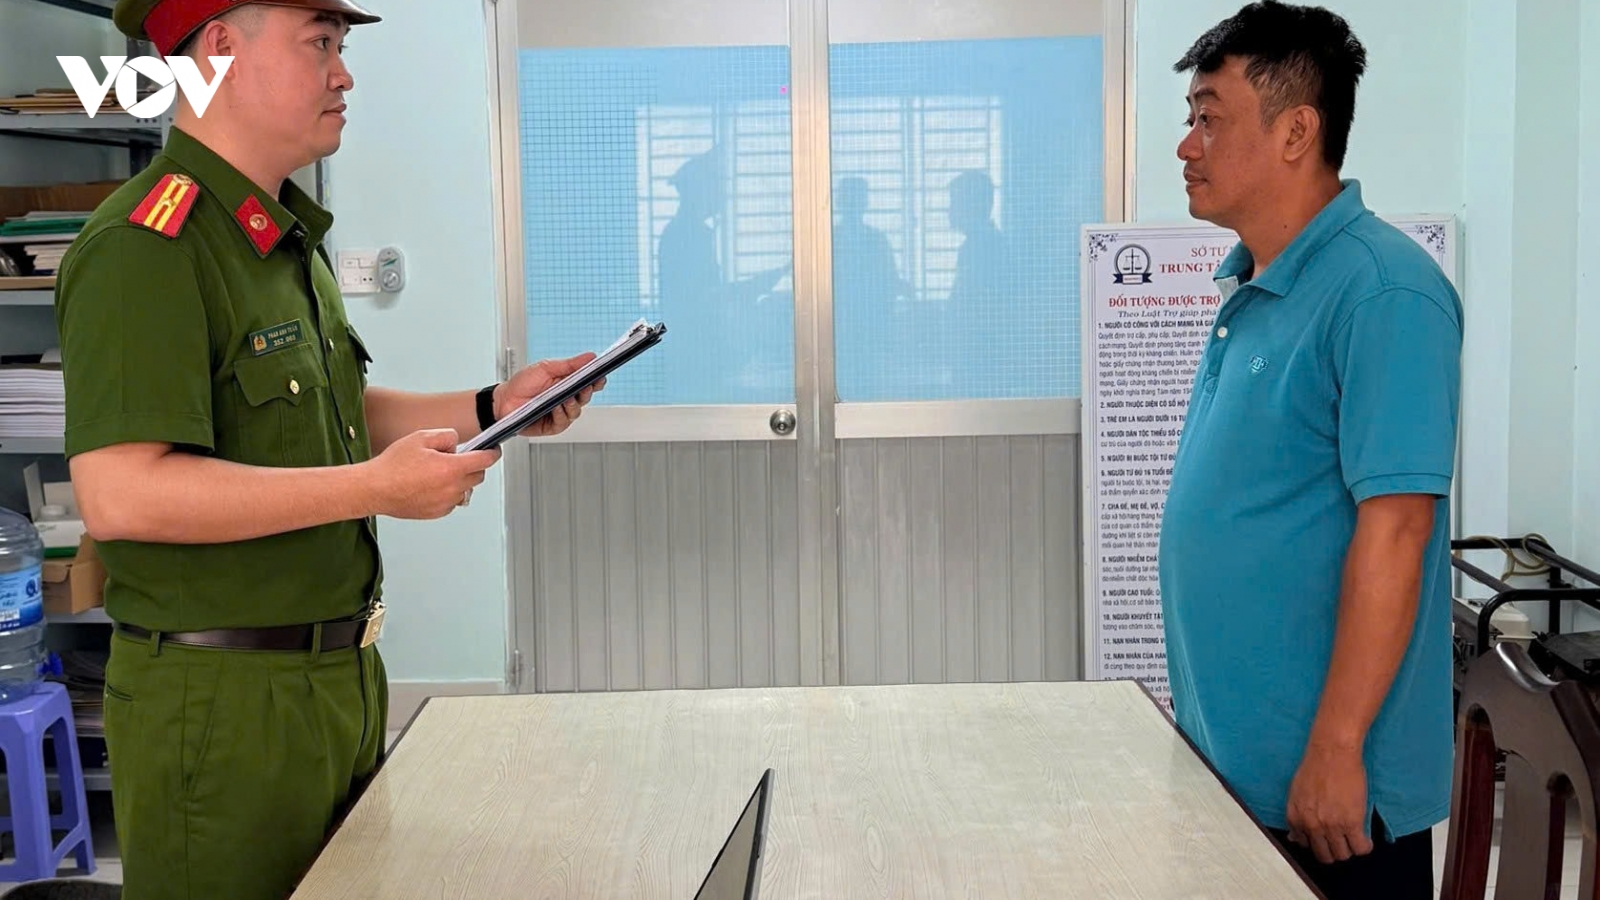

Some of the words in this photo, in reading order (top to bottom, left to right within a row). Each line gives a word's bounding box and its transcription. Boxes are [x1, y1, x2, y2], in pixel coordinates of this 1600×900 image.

[1191, 245, 1206, 257] SỞ
[1209, 246, 1228, 256] TƯ
[1159, 263, 1202, 273] TRUNG
[1207, 259, 1220, 272] TÂ
[1109, 293, 1127, 307] ĐỐI
[1130, 296, 1165, 308] TƯỢNG
[1168, 296, 1197, 307] ĐƯỢC
[1200, 295, 1220, 307] TRỢ
[1118, 310, 1139, 318] Theo
[1142, 310, 1160, 319] Luật
[1163, 310, 1178, 318] Trợ
[1180, 309, 1199, 319] giúp
[1201, 308, 1216, 318] phá
